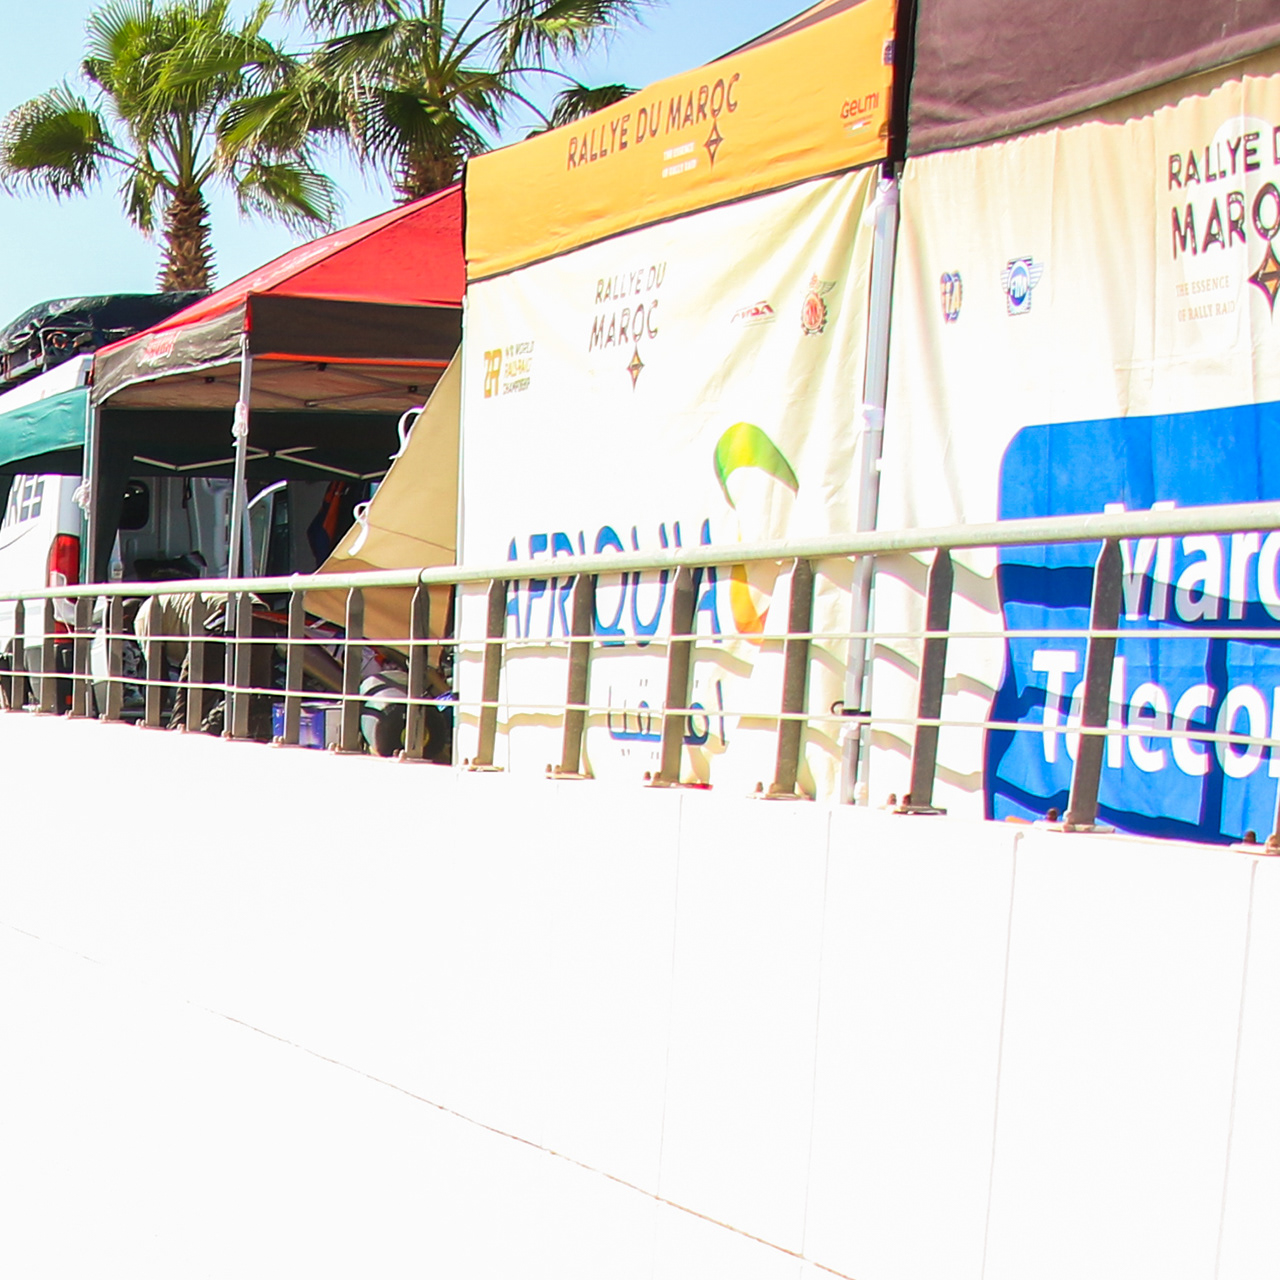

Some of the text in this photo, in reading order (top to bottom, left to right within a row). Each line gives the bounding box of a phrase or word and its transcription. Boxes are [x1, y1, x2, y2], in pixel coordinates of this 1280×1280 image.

[567, 73, 740, 171] RALLYE DU MAROC
[1168, 132, 1260, 191] RALLYE
[595, 262, 667, 304] RALLYE DU
[589, 299, 659, 352] MAROC
